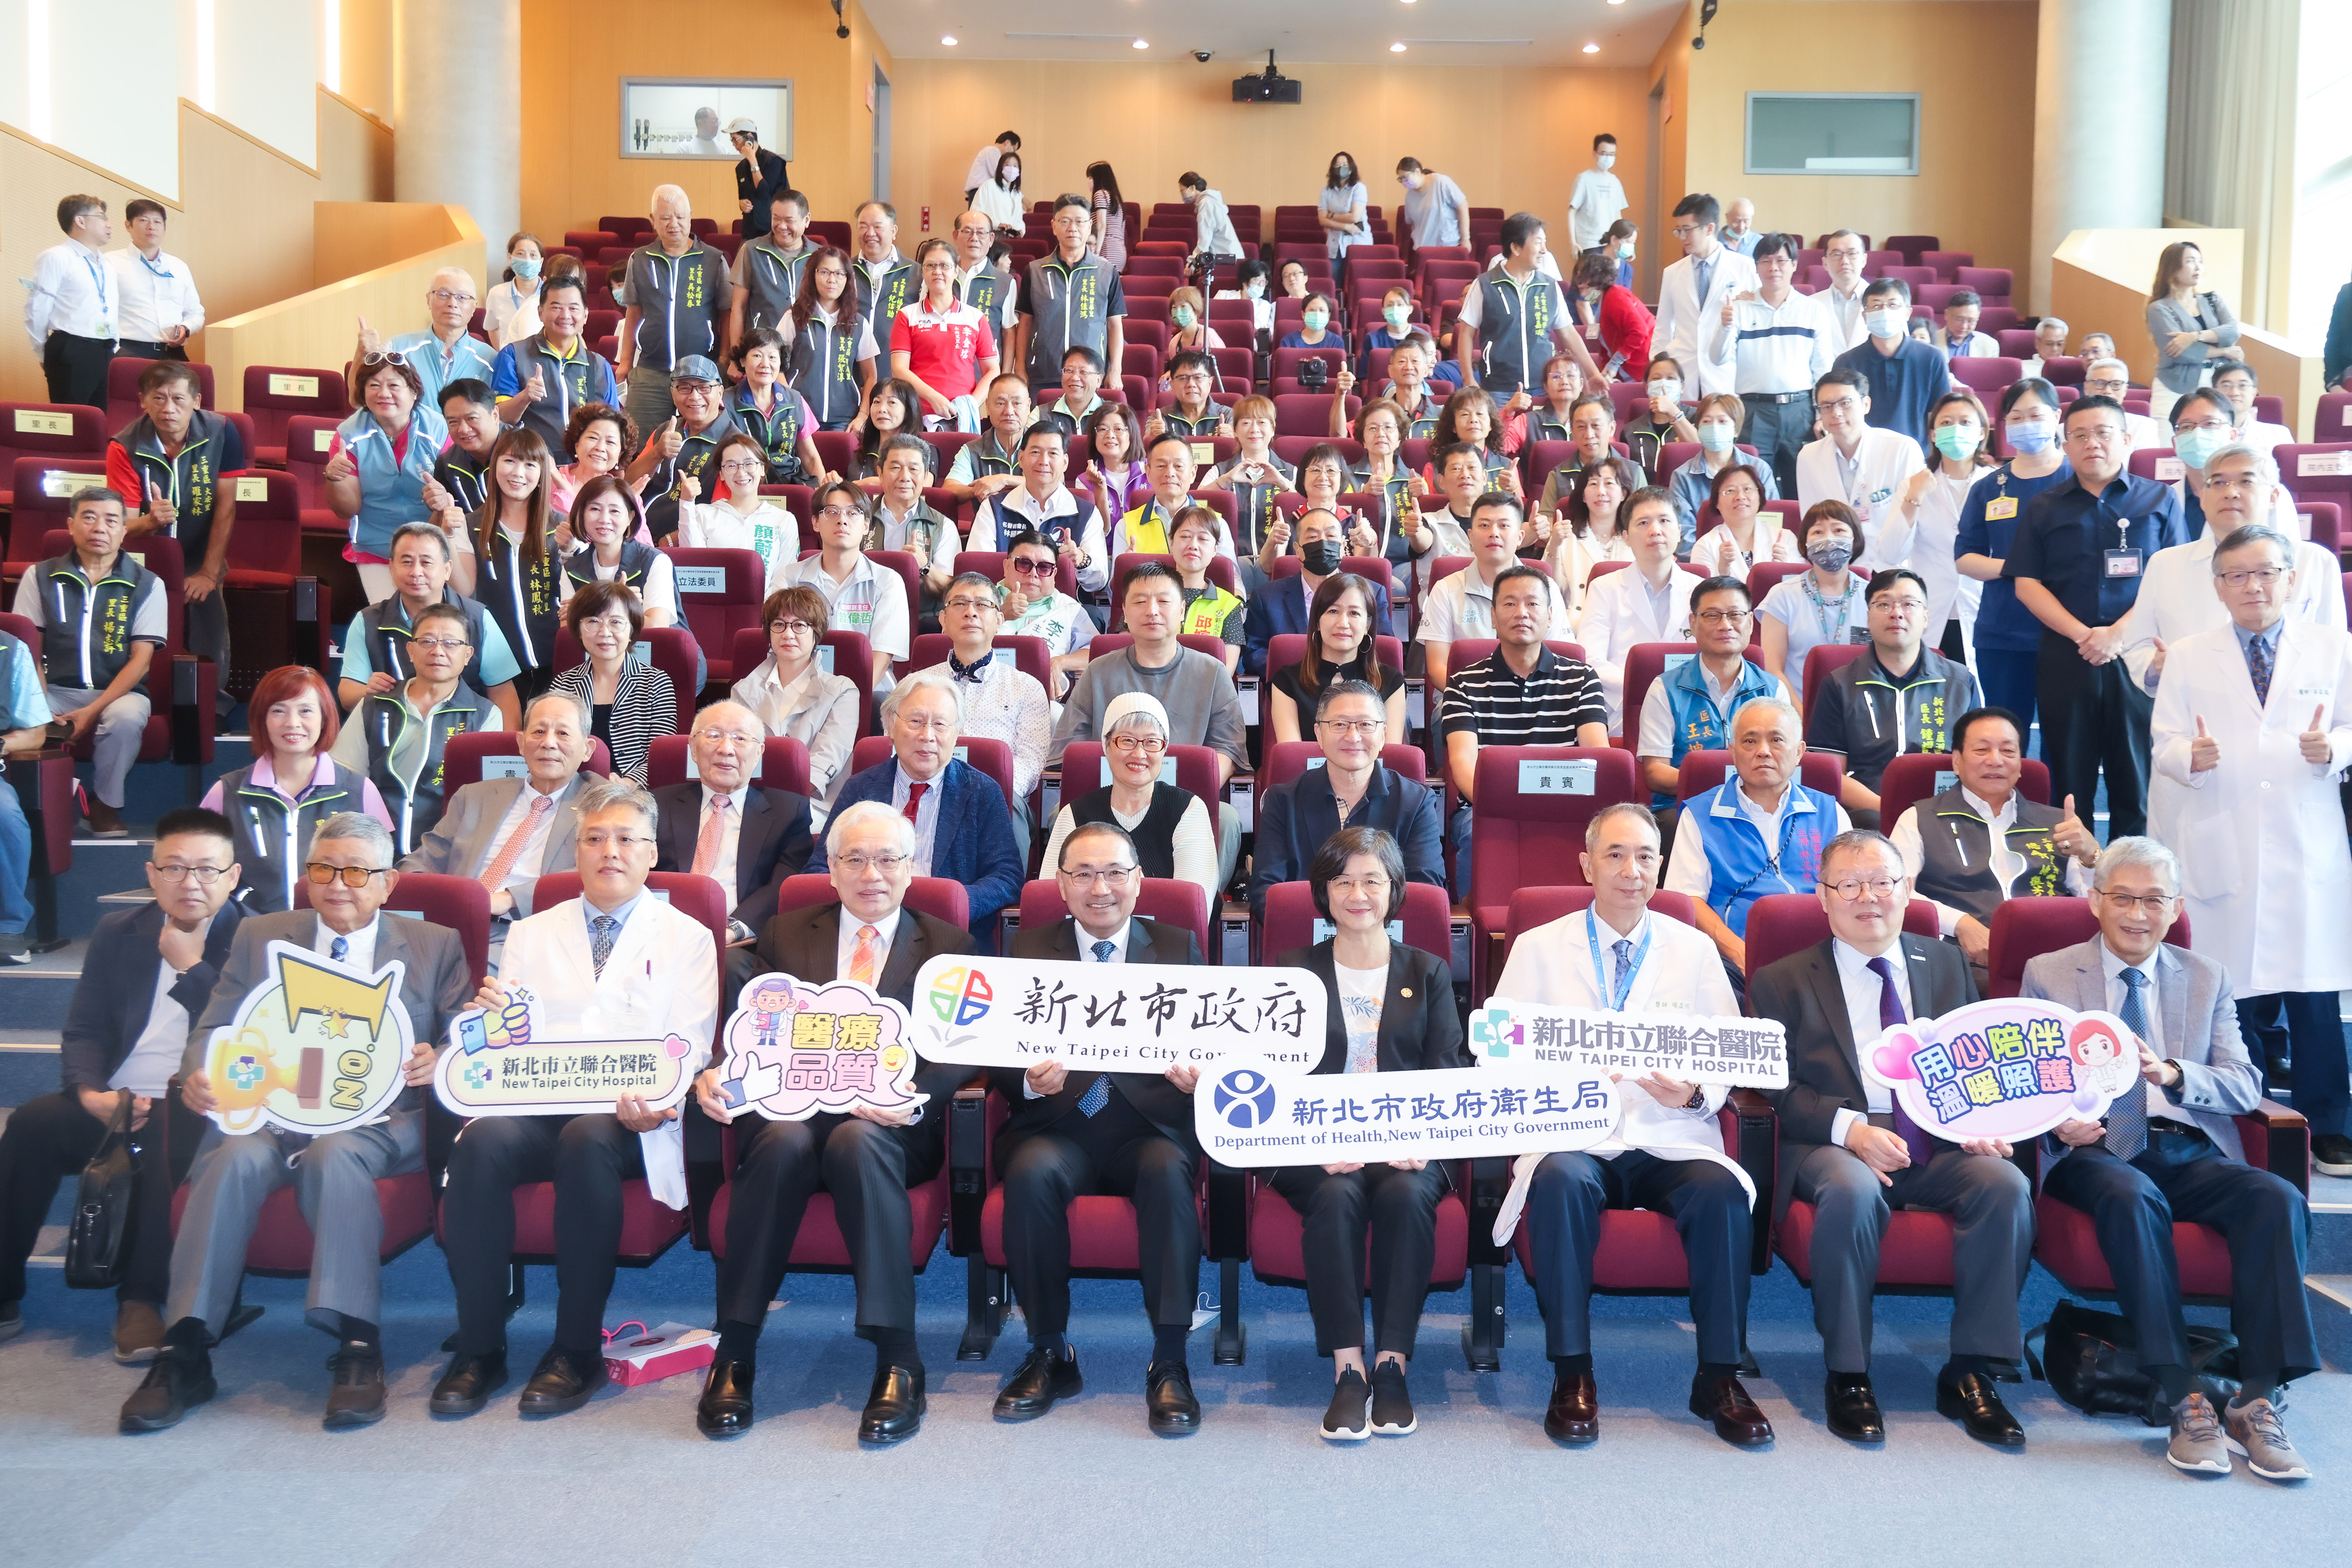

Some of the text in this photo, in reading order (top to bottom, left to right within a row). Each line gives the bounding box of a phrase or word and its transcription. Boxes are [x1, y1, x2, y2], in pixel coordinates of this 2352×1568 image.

[688, 268, 695, 281] 里長
[898, 278, 906, 297] 三重區
[978, 289, 985, 303] 里長
[1081, 278, 1088, 293] 里長
[985, 287, 993, 306] 三重區
[838, 336, 846, 351] 里長
[577, 378, 585, 394] 里長
[32, 420, 57, 429] 里長
[780, 421, 788, 439] 里長
[191, 464, 203, 516] 里長 羅家林
[200, 456, 212, 511] 三重區 大安里
[1265, 489, 1273, 503] 里長
[1394, 493, 1403, 507] 里長
[543, 548, 551, 577] 三重區
[678, 577, 716, 587] 立法委員
[529, 579, 543, 615] 林鳳秋
[106, 598, 117, 618] 里長
[119, 595, 129, 622] 三重區
[840, 611, 872, 625] 曾偉哲
[1920, 703, 1932, 724] 區長
[1932, 696, 1945, 727] 新北市
[1700, 710, 1713, 738] 區長
[1539, 776, 1574, 789] 貴賓
[1797, 829, 1809, 846] 主席
[1012, 976, 1307, 1038] 新北市政府
[791, 1012, 883, 1051] 醫療
[1532, 1016, 1782, 1062] 新北市立聯合醫院
[1016, 1040, 1310, 1063] New Taipei City Goment
[1535, 1048, 1780, 1076] NEW TAIPEI CITY HOSPITAL
[1912, 1018, 2065, 1089] 用心陪伴
[501, 1054, 657, 1075] 新北市立聯合醫院
[785, 1053, 877, 1092] 品質
[502, 1073, 657, 1090] New Taipei City Hospital
[1927, 1057, 2076, 1124] 溫暖照護
[1292, 1080, 1609, 1125] 新北市政府衛生局
[1214, 1133, 1307, 1151] Department
[1311, 1132, 1326, 1145] of
[1426, 1125, 1473, 1142] Taipei
[1478, 1122, 1509, 1140] City
[1513, 1117, 1610, 1135] Government
